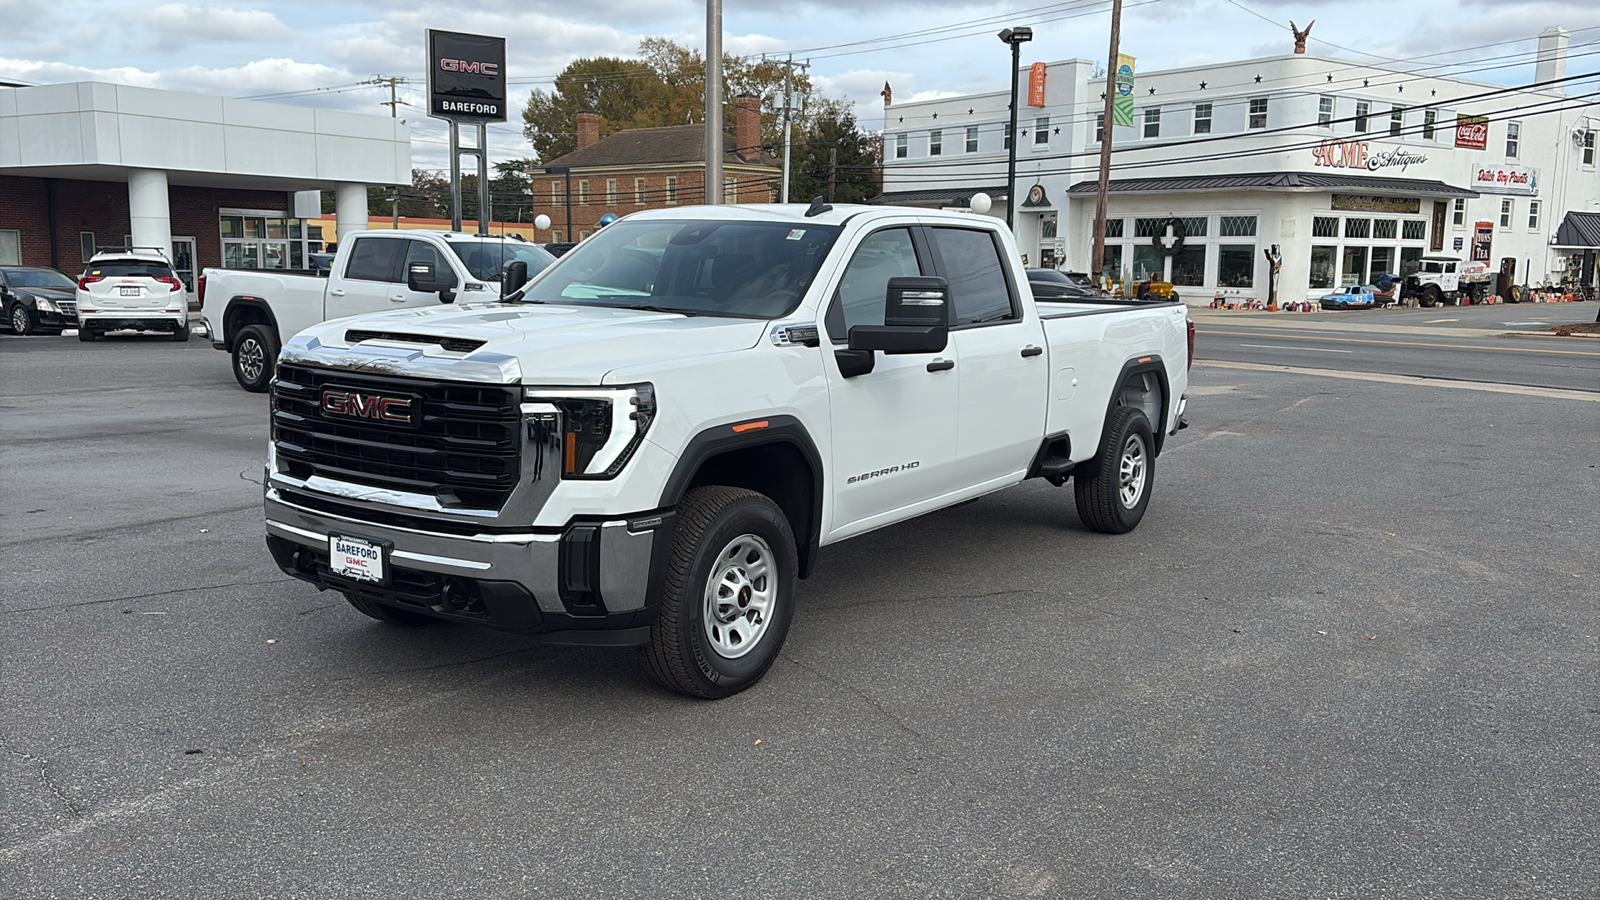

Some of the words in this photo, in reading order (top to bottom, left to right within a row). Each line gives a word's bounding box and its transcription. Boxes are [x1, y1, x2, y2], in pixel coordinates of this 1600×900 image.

[441, 58, 498, 75] GMC
[442, 101, 497, 114] BAREFORD
[1312, 138, 1370, 169] ACME
[1368, 145, 1429, 172] Antiques
[1477, 168, 1495, 182] Dutch
[1496, 170, 1509, 185] Boy
[1509, 171, 1528, 184] Paints
[1055, 247, 1064, 255] 25
[1476, 248, 1488, 259] TEA
[323, 390, 411, 423] GMC
[847, 466, 899, 484] SIERRA
[901, 461, 920, 471] HD
[336, 542, 378, 560] BAREFORD
[345, 556, 368, 568] GMC
